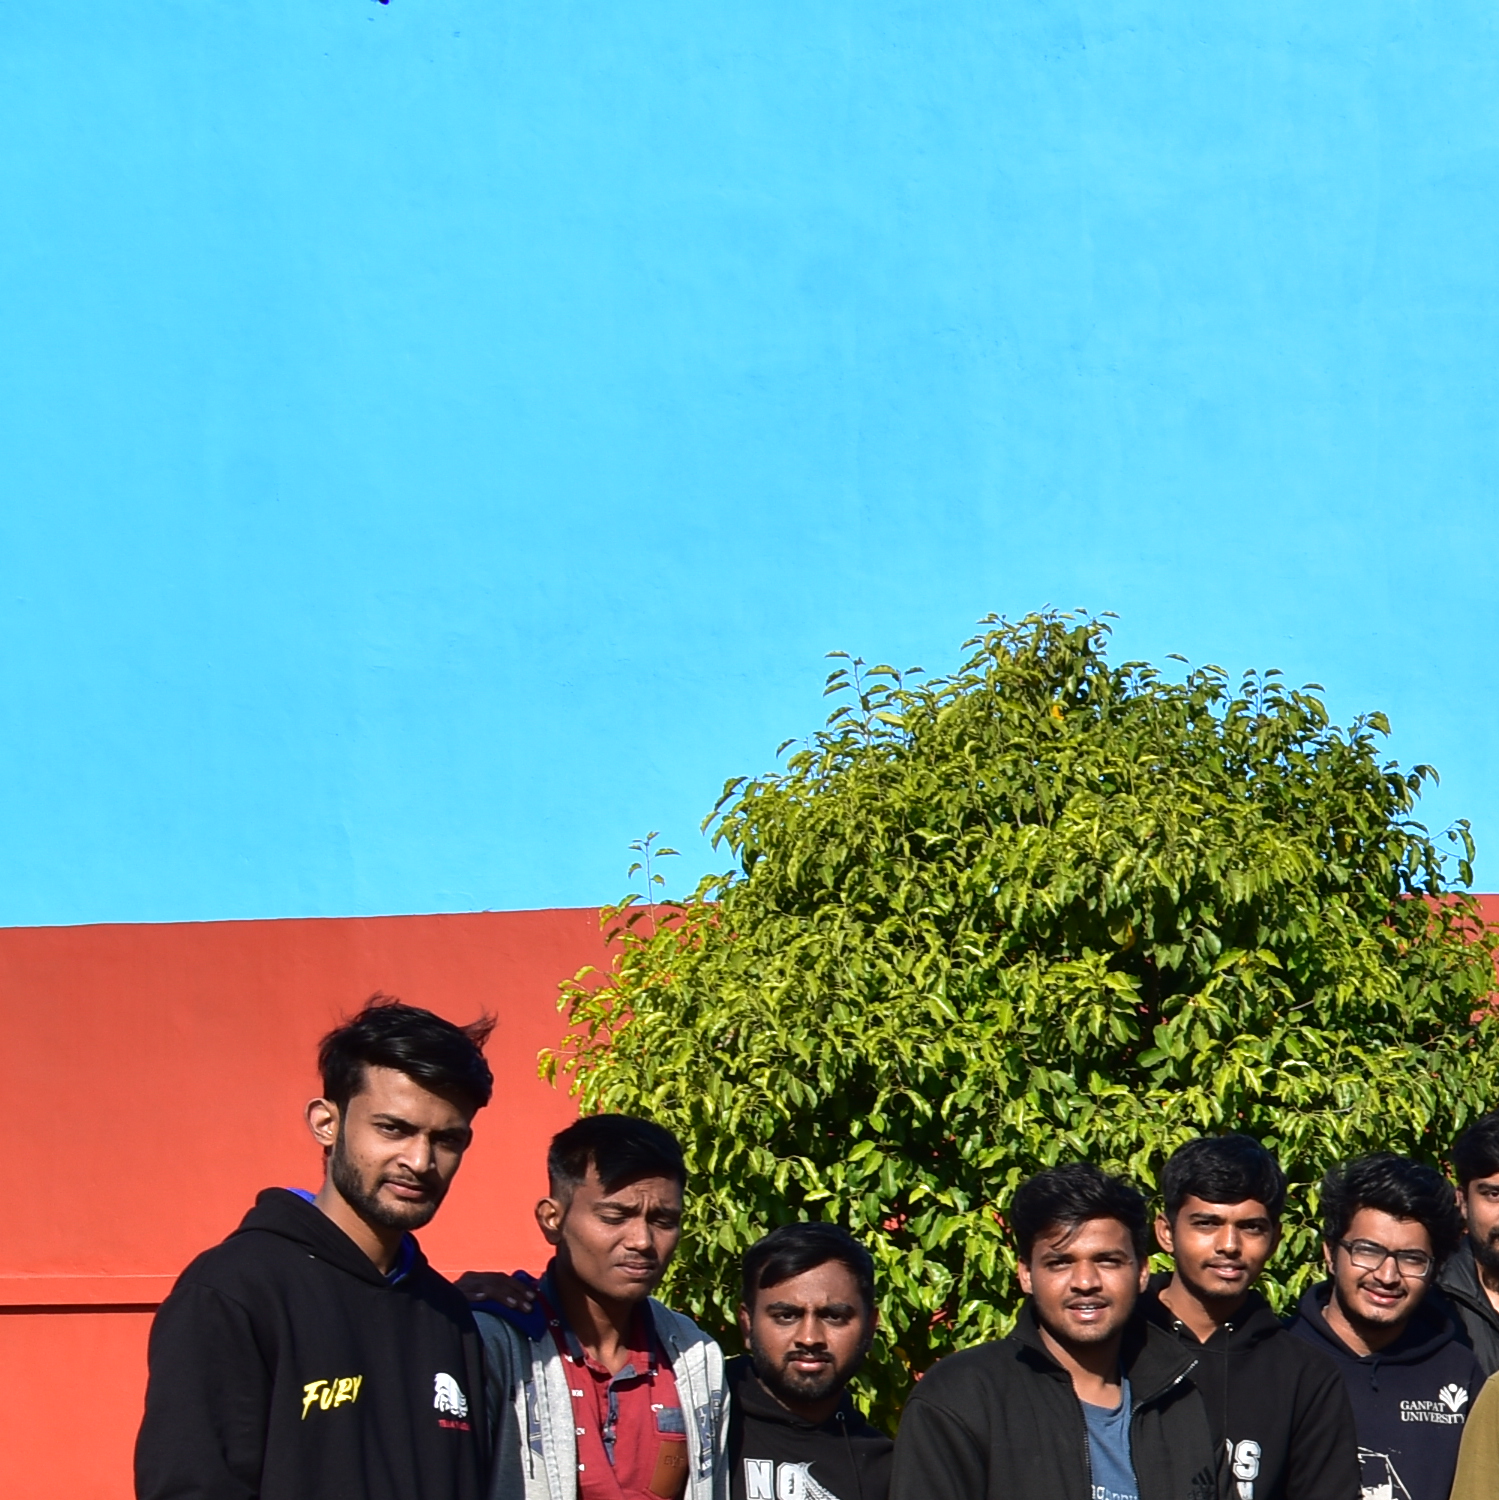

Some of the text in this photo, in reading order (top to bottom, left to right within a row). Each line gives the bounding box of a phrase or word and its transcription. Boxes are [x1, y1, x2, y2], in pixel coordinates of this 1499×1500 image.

[301, 1375, 363, 1420] FURY
[1400, 1400, 1446, 1412] GANPAT
[1400, 1411, 1466, 1424] UNIVERSITY
